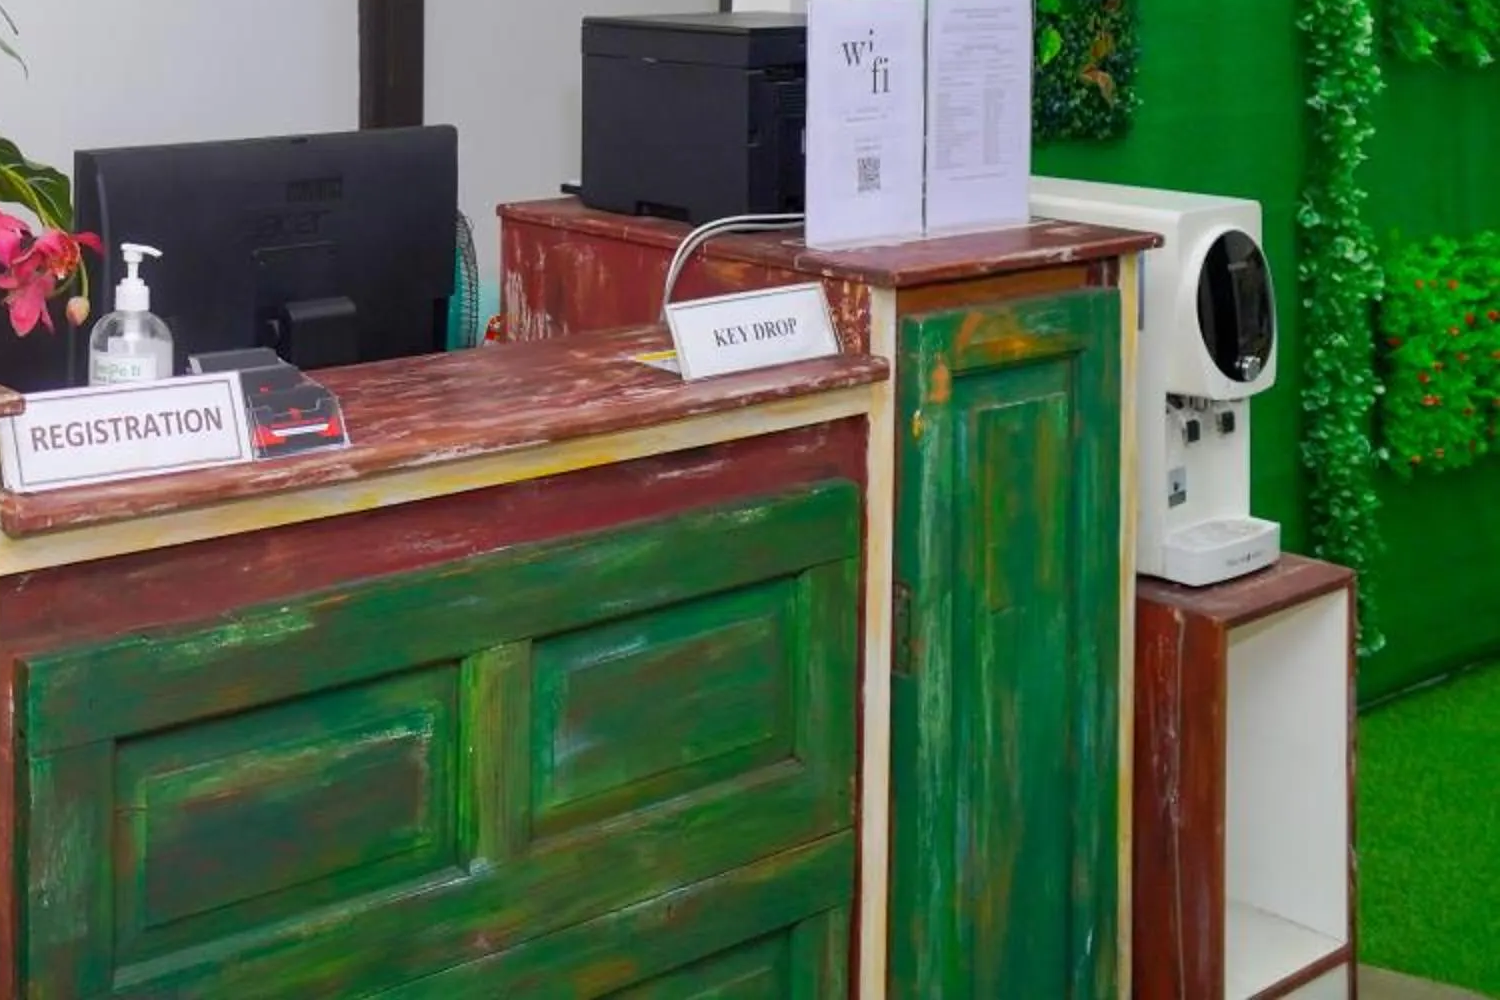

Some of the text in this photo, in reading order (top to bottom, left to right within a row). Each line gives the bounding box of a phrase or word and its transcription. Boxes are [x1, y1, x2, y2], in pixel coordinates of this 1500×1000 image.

[712, 316, 797, 348] KEY DROP
[29, 405, 224, 453] REGISTRATION
